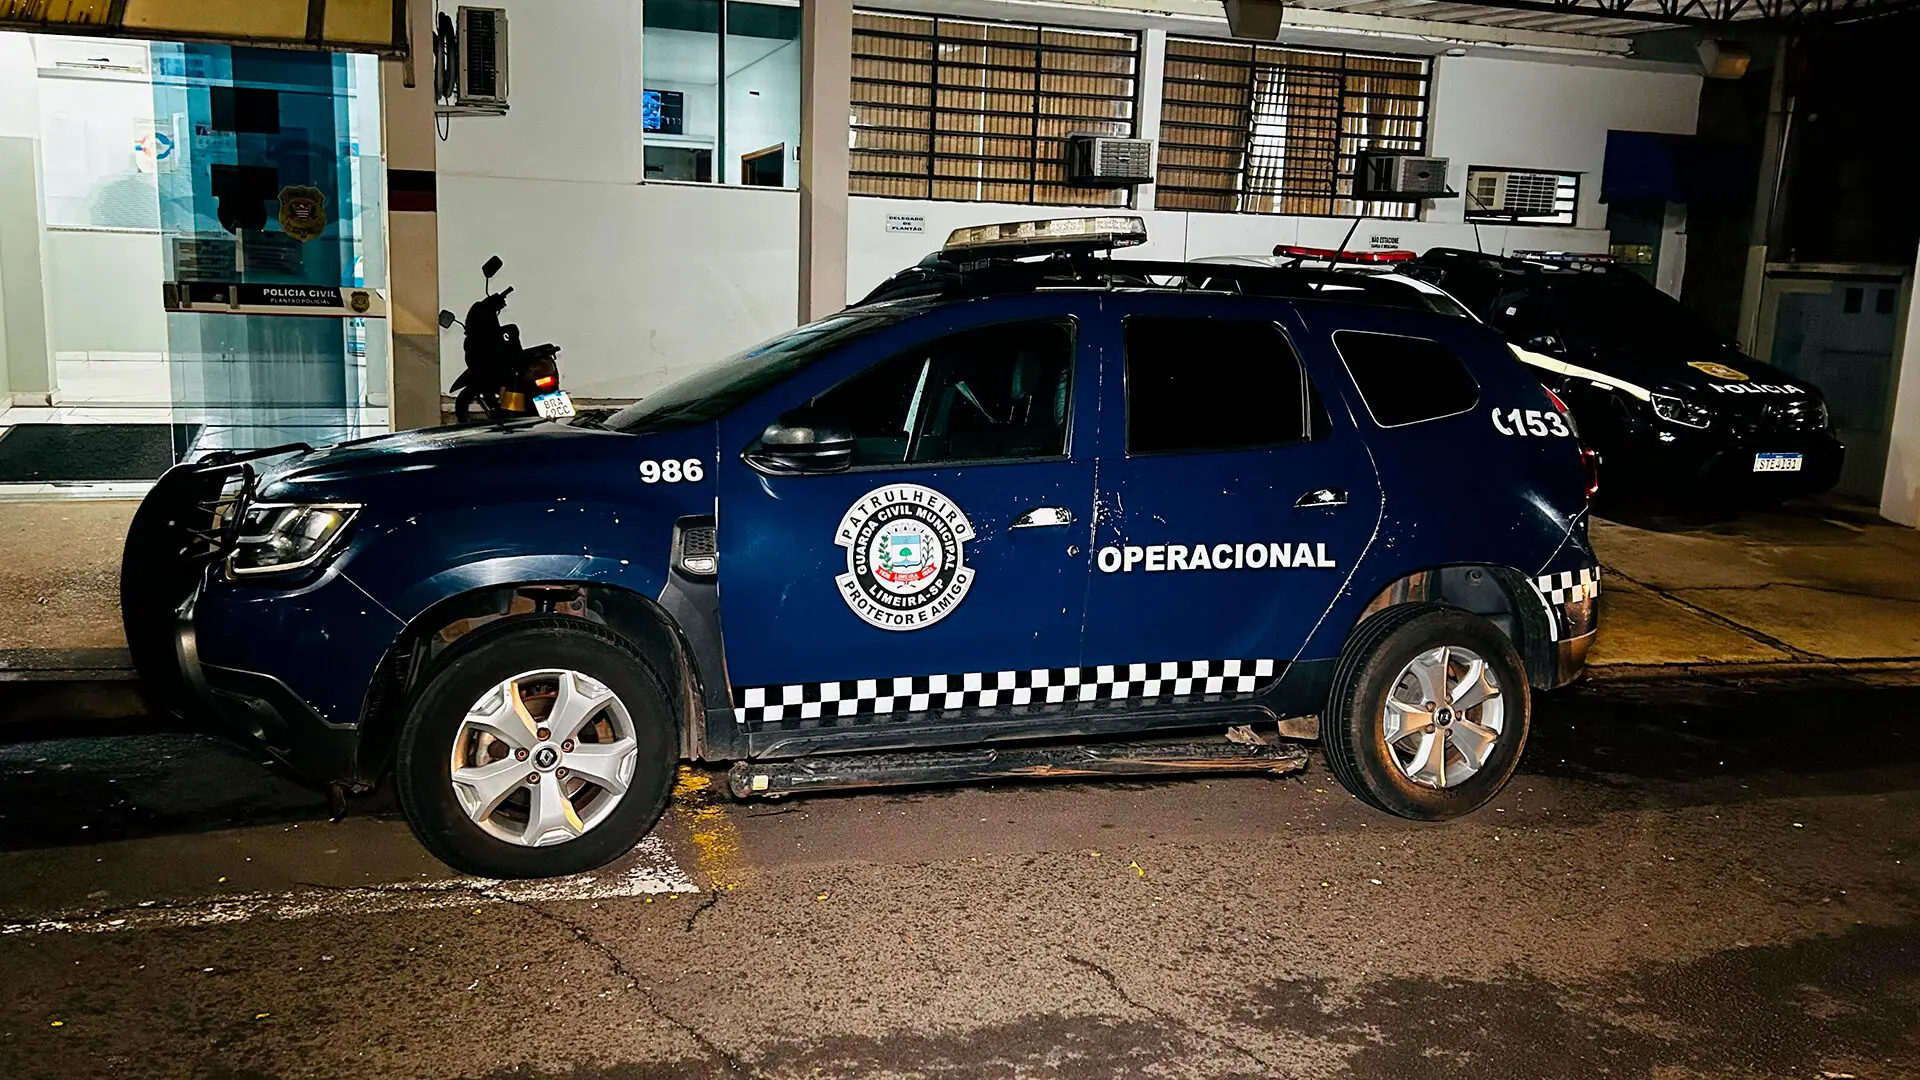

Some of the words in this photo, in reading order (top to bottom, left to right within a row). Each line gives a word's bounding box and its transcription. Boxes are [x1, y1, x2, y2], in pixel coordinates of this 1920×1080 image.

[262, 287, 306, 297] POLÍCIA
[308, 289, 337, 298] CIVIL
[1507, 408, 1570, 437] 153
[639, 458, 704, 483] 986
[841, 489, 966, 540] PATRULHEIRO
[855, 520, 879, 575] GUARDA
[877, 505, 913, 522] CIVIL
[915, 507, 955, 571] MUNICIPAL
[1097, 542, 1337, 573] OPERACIONAL
[844, 581, 915, 625] PROTETOR
[918, 610, 928, 622] E
[931, 573, 967, 616] AMIGO
[868, 579, 944, 607] LIMEIRA-SP
